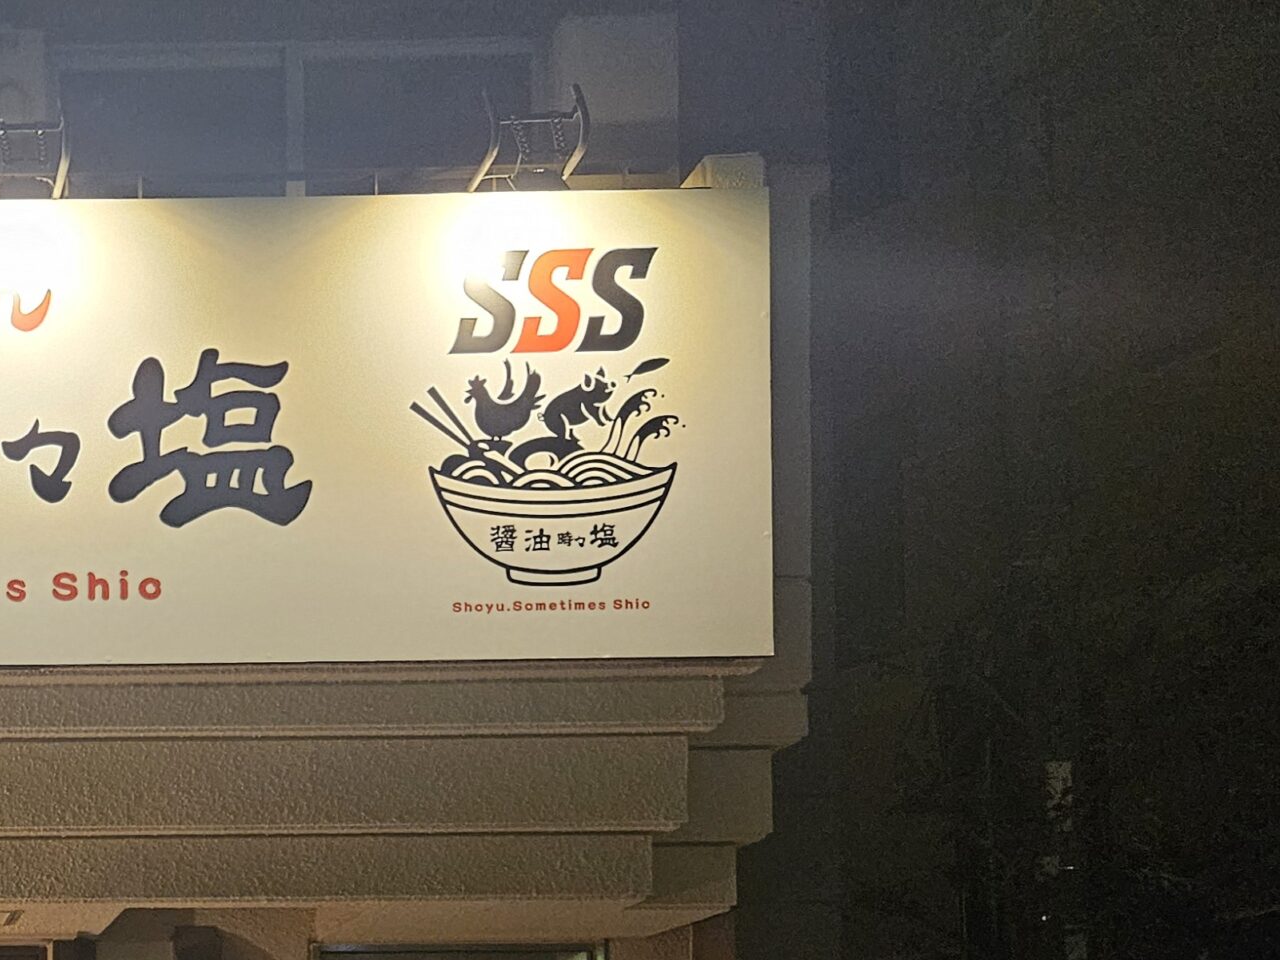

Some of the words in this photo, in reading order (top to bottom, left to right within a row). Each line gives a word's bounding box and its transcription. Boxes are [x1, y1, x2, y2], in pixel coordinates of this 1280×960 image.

[447, 247, 658, 355] SSS
[490, 523, 619, 552] 醤油時々塩
[52, 571, 163, 604] Shio
[452, 598, 607, 613] Shoyu.Sometimes
[613, 598, 650, 611] Shio
